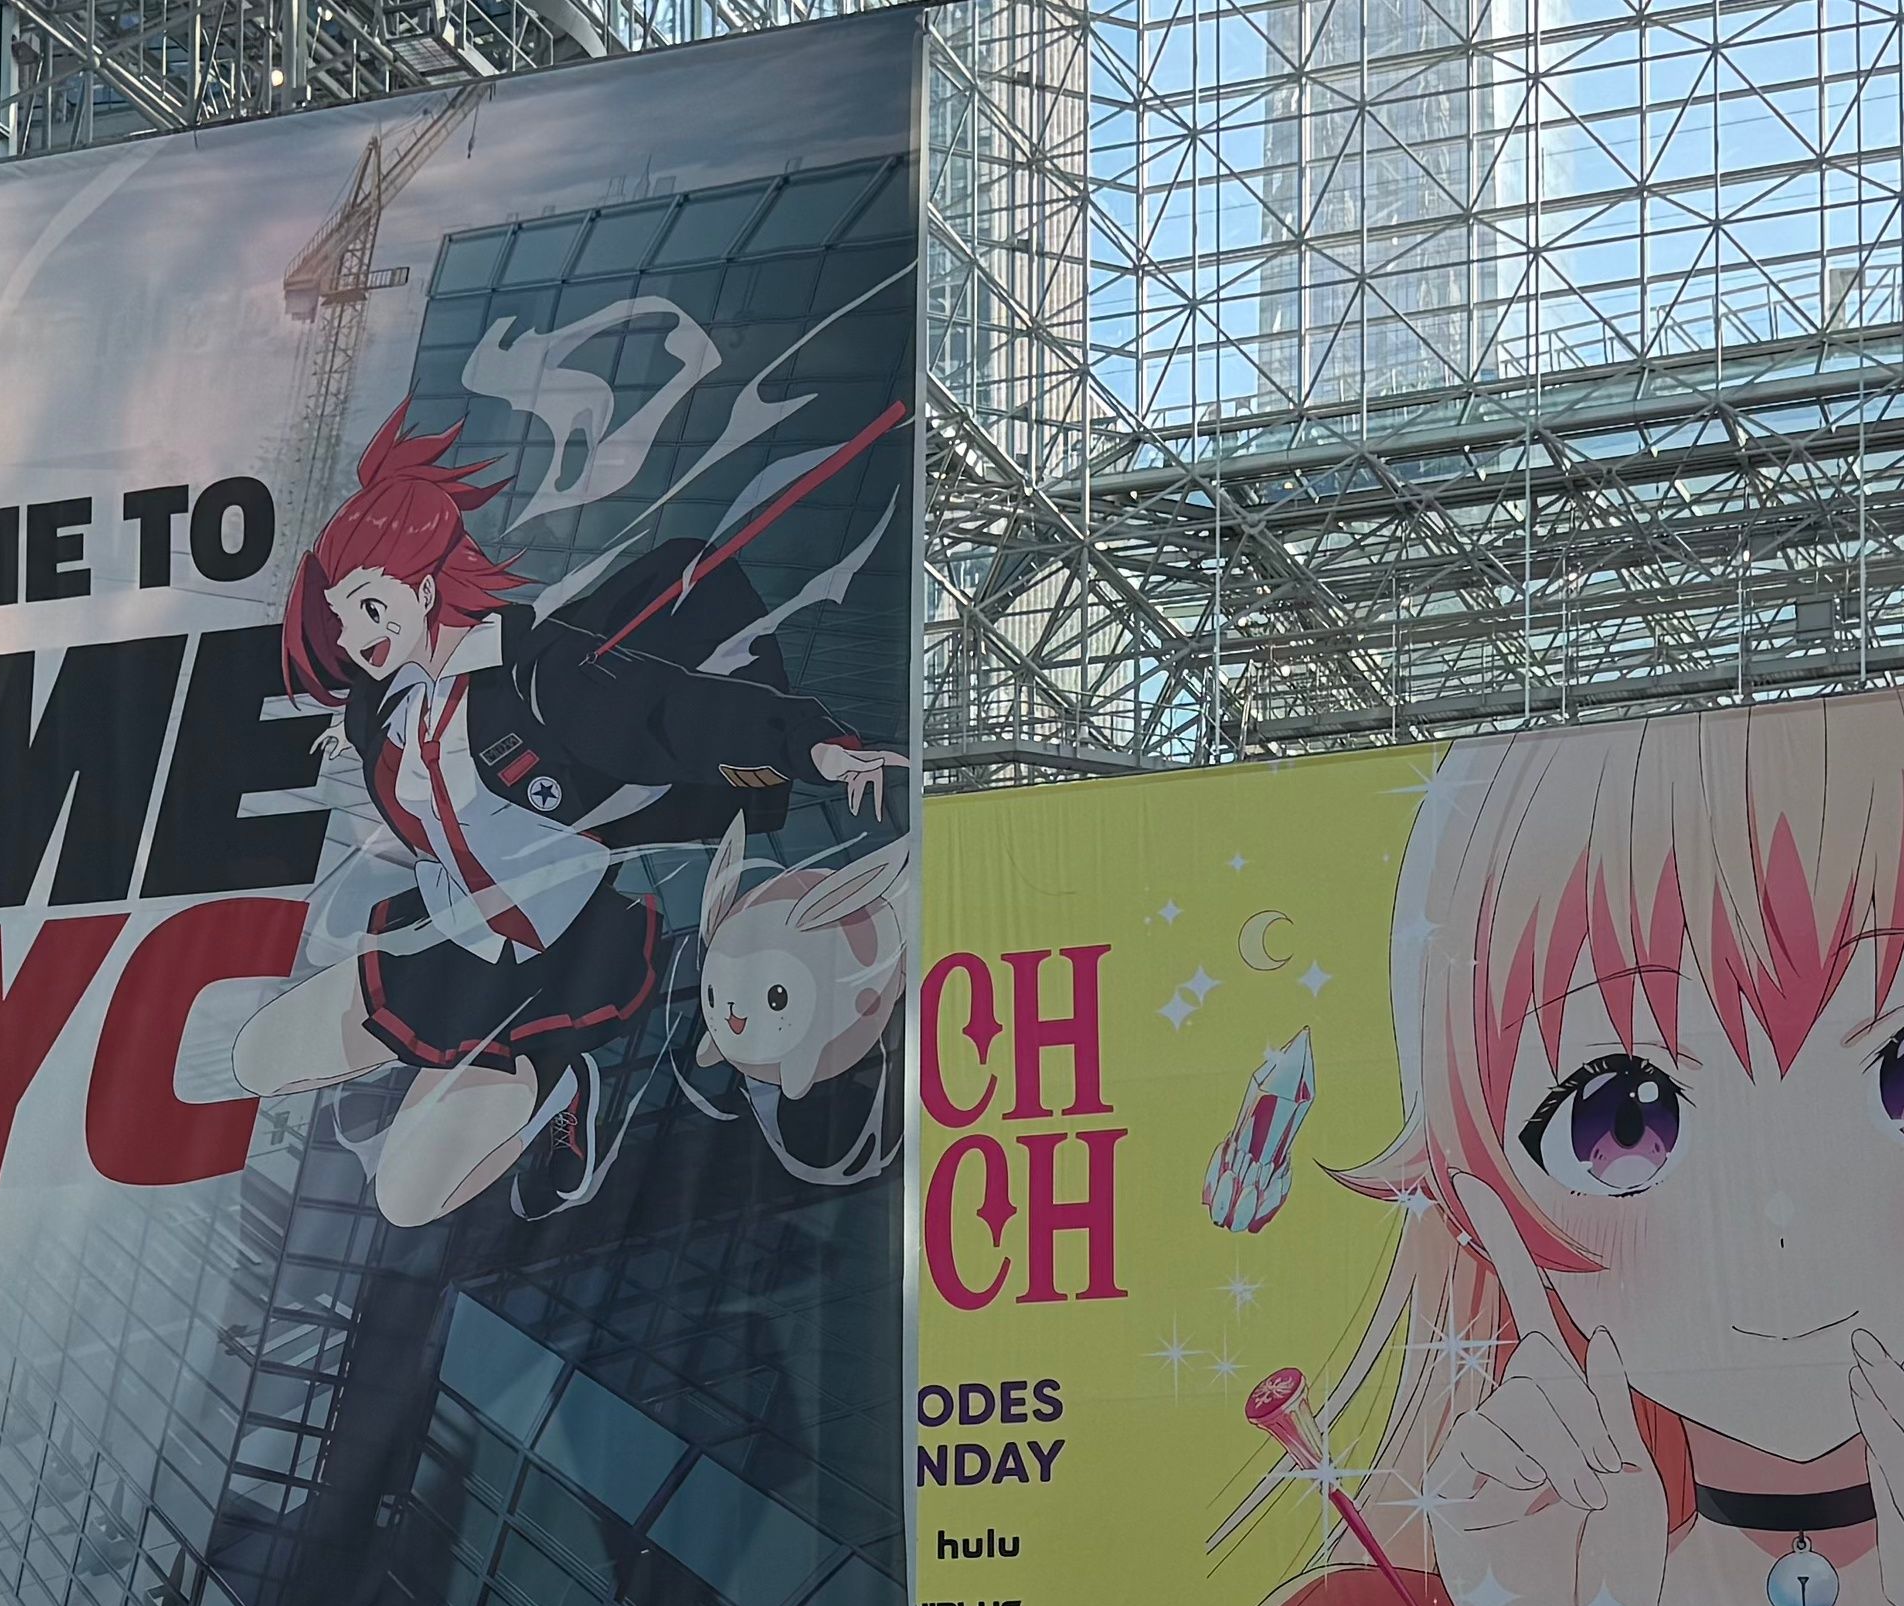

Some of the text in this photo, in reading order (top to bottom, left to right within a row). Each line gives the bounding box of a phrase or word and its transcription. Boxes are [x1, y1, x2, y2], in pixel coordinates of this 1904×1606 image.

[123, 476, 276, 583] TO
[920, 944, 1114, 1128] CH
[924, 1129, 1129, 1310] CH
[918, 1379, 1063, 1427] ODES
[917, 1440, 1065, 1486] NDAY
[937, 1529, 1019, 1559] hulu
